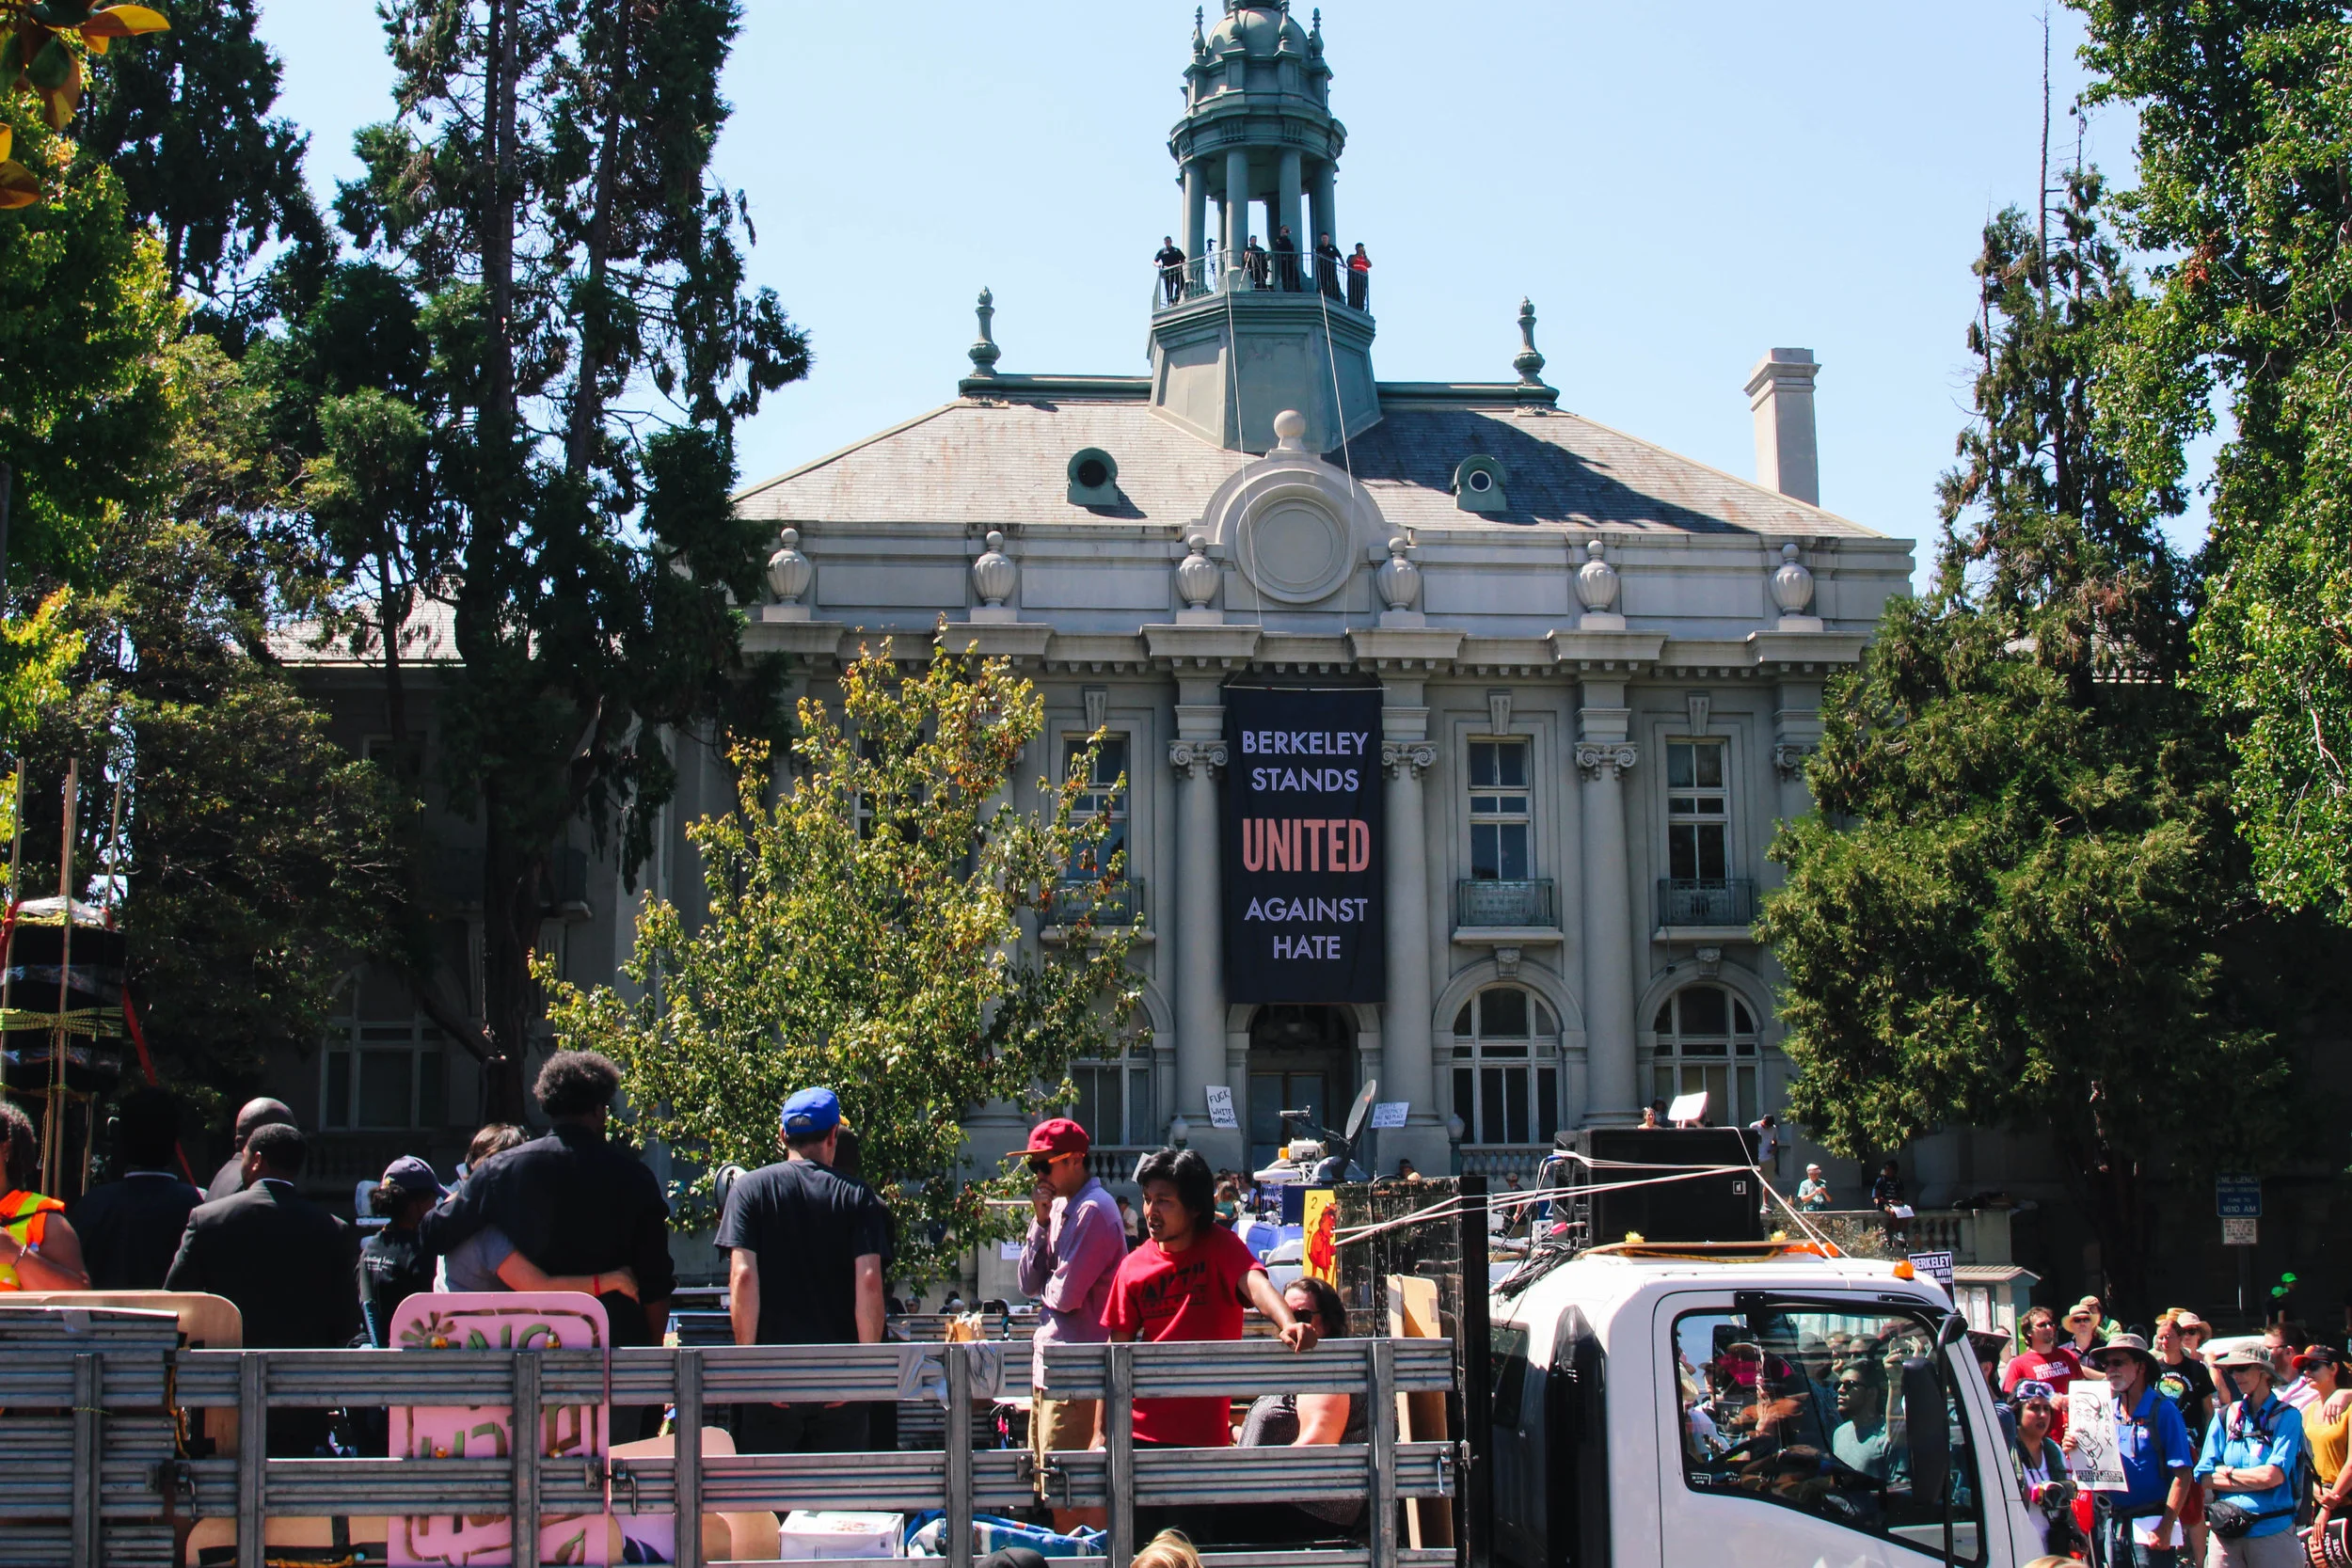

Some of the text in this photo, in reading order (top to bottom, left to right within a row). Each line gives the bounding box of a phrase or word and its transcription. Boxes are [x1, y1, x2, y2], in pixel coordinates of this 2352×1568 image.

[1242, 730, 1369, 755] BERKELEY
[1251, 767, 1359, 792] STANDS
[1242, 817, 1370, 872] UNITED
[1244, 896, 1368, 923] AGAINST
[1273, 934, 1341, 959] HATE
[1209, 1088, 1230, 1103] FUCK
[1211, 1107, 1233, 1117] WHITE
[1311, 1196, 1318, 1210] 2
[1911, 1255, 1950, 1270] BERKELEY
[1935, 1268, 1951, 1276] WITH
[2036, 1366, 2071, 1381] ALTERNATIVE
[2102, 1401, 2112, 1448] MARX
